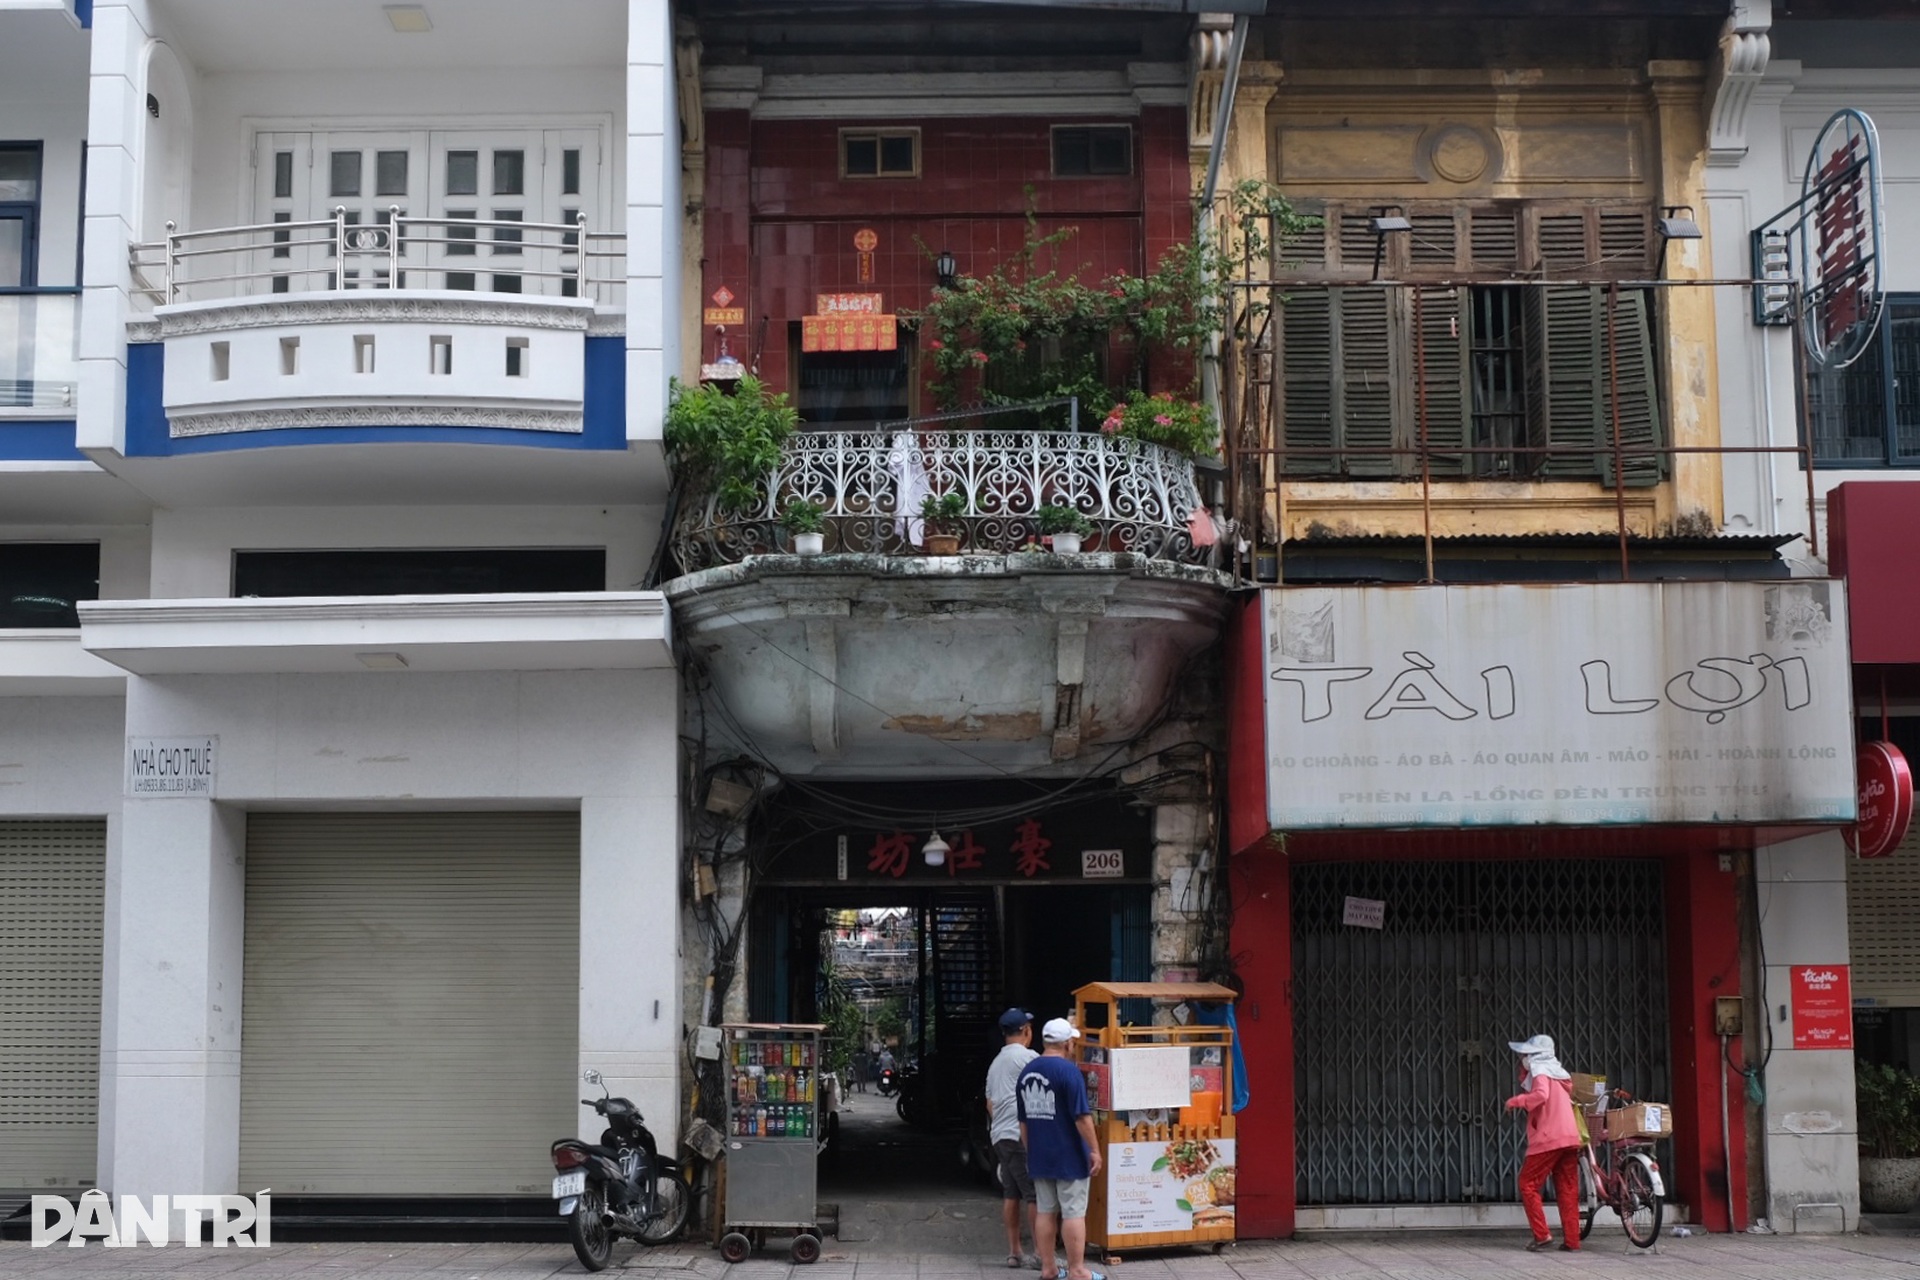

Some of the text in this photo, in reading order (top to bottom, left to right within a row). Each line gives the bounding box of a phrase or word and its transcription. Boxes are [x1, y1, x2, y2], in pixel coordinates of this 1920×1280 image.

[1271, 651, 1811, 724] TÀI LỢI
[132, 740, 211, 776] NHÀ CHO THUÊ
[1302, 753, 1379, 768] CHOÀNG
[1397, 752, 1422, 766] ÁO
[1473, 751, 1498, 765] ÁO
[1505, 752, 1554, 766] QUAN
[1561, 749, 1589, 763] ÂM
[1668, 746, 1698, 760] HÀI
[1718, 745, 1780, 760] HOÀNH
[1788, 745, 1836, 761] LỘNG
[1554, 785, 1608, 799] ĐÈN
[1618, 785, 1707, 799] TRUNG
[1085, 852, 1121, 870] 206
[1188, 1181, 1210, 1193] ONLY
